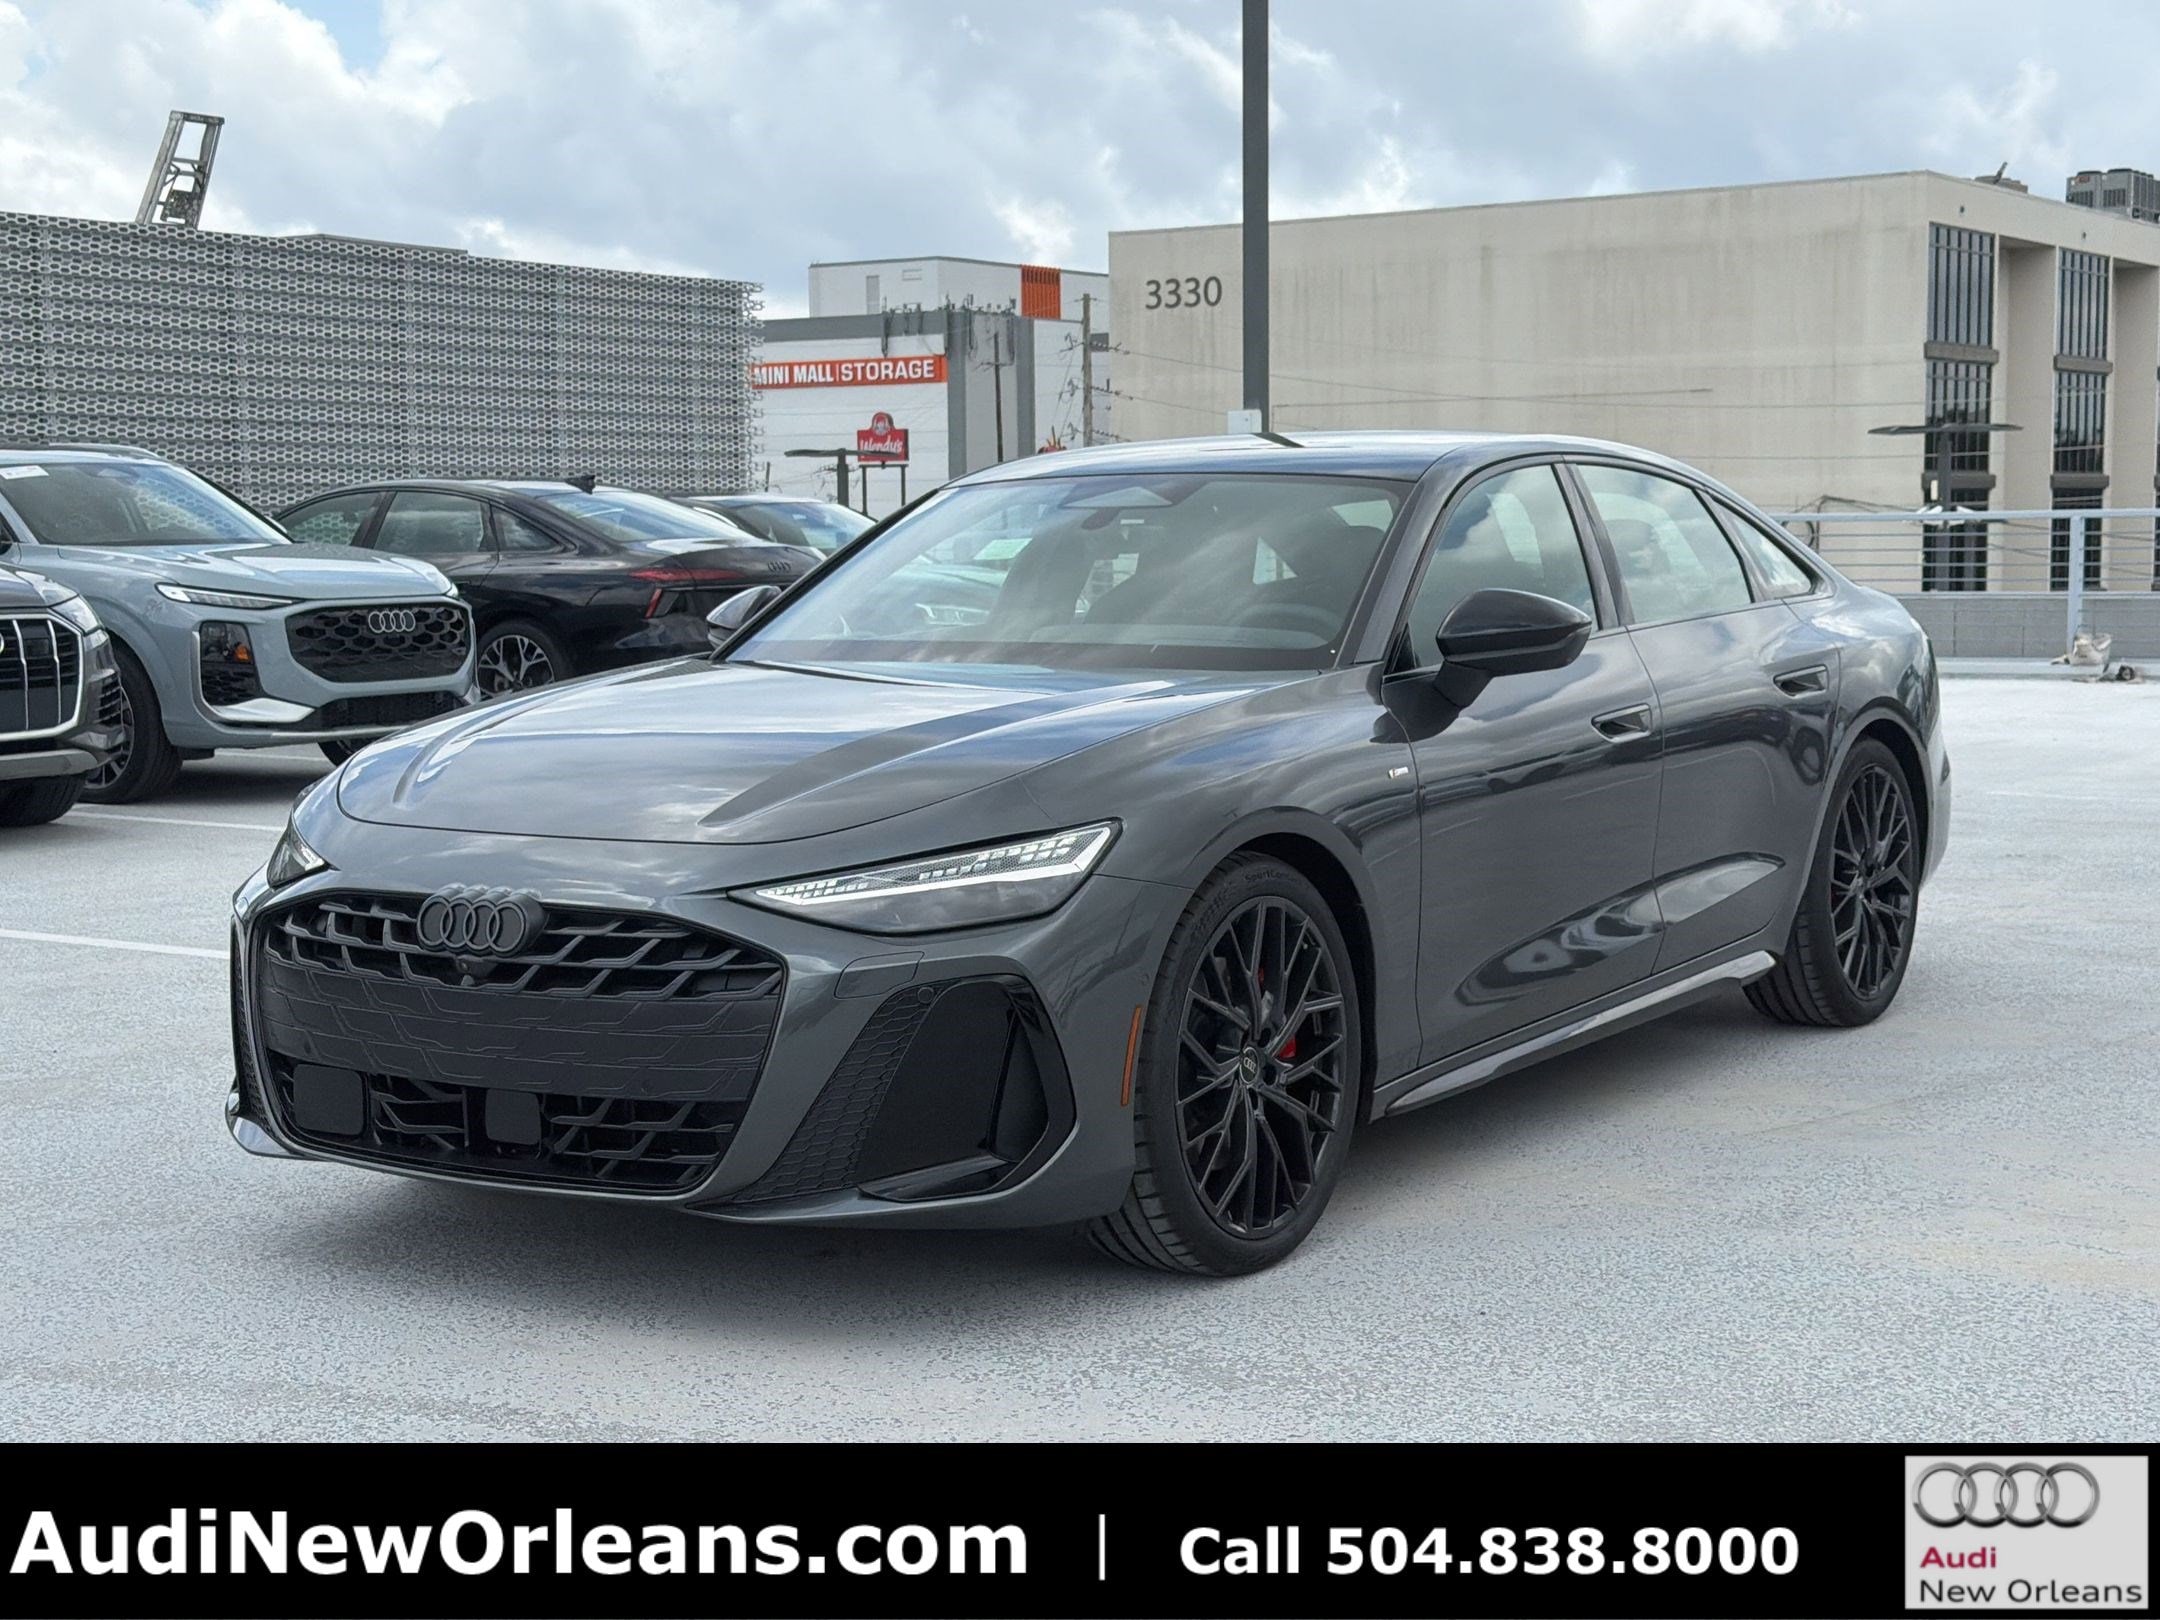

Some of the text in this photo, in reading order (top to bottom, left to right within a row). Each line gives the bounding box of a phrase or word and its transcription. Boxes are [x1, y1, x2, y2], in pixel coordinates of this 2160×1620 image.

[1145, 275, 1223, 310] 3330
[754, 359, 935, 385] MINI MALL STORAGE
